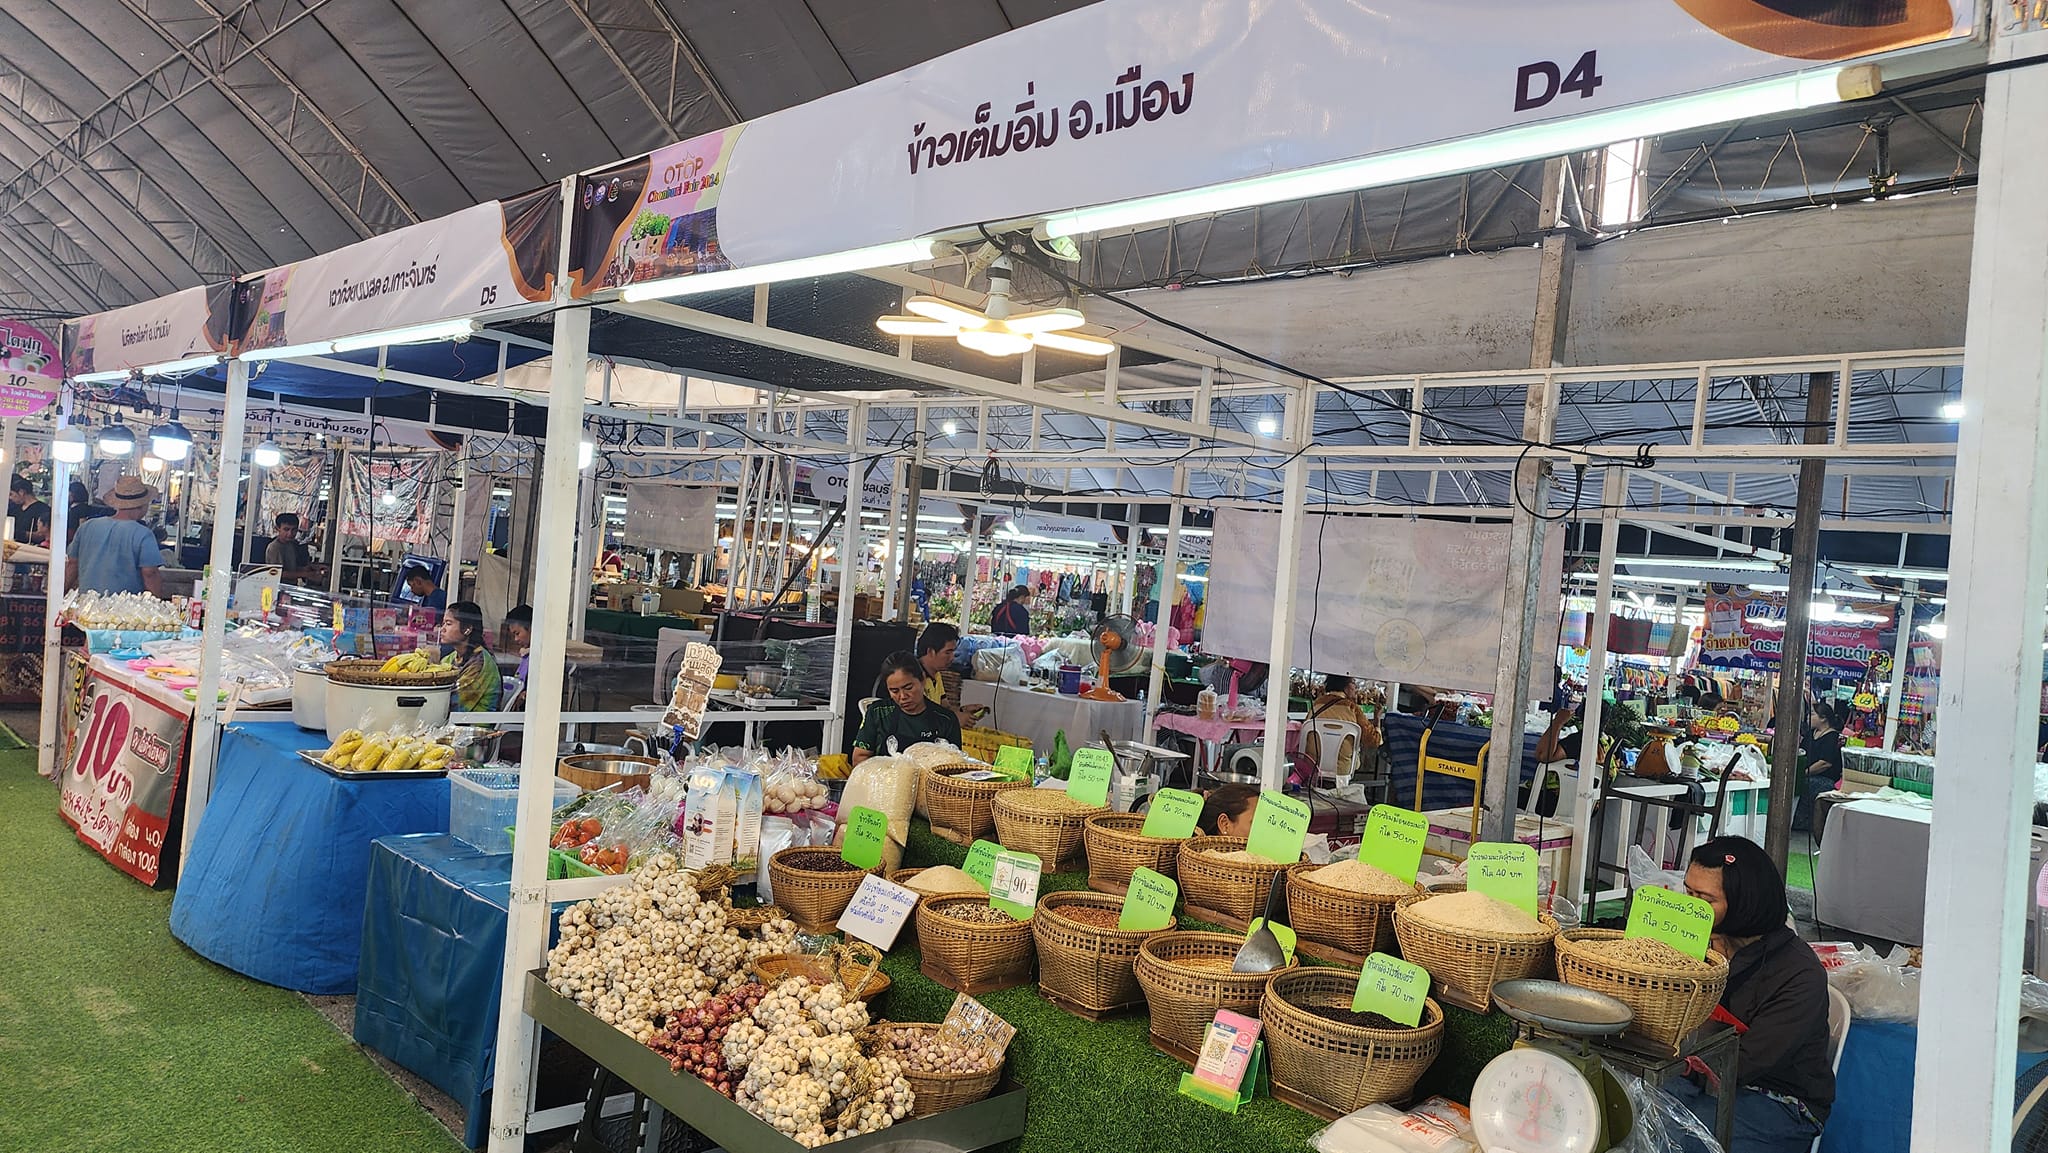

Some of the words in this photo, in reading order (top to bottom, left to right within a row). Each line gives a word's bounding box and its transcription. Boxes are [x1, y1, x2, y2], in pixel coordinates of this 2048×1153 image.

[1513, 50, 1603, 113] D4
[907, 81, 1059, 175] ข้าวเต็มอิ่ม
[1068, 64, 1195, 141] อ.เมือง
[663, 156, 704, 185] OTOP
[647, 182, 682, 204] Chonburi
[682, 179, 700, 194] Fair
[699, 172, 720, 191] 2024
[382, 254, 440, 295] อ.เกาะจันทร์
[480, 285, 497, 307] D5
[294, 418, 301, 427] 8
[342, 425, 370, 437] 2567
[1705, 634, 1750, 651] จำหน่าย
[76, 695, 131, 782] 10
[1437, 762, 1467, 775] STANLEY
[107, 769, 132, 806] บาท
[1267, 814, 1277, 826] กิโล
[1287, 826, 1297, 835] บาท
[1378, 824, 1391, 837] กิโล
[1392, 830, 1404, 842] 50
[1404, 836, 1419, 846] บาท
[1481, 865, 1494, 878] กิโล
[1495, 868, 1507, 878] 40
[1509, 871, 1523, 879] บาท
[1012, 876, 1035, 895] 90.-
[1643, 911, 1658, 928] กิโล
[1661, 920, 1678, 934] 50
[1680, 929, 1699, 942] บาท
[1391, 984, 1402, 998] 70
[1403, 993, 1415, 1004] บาท
